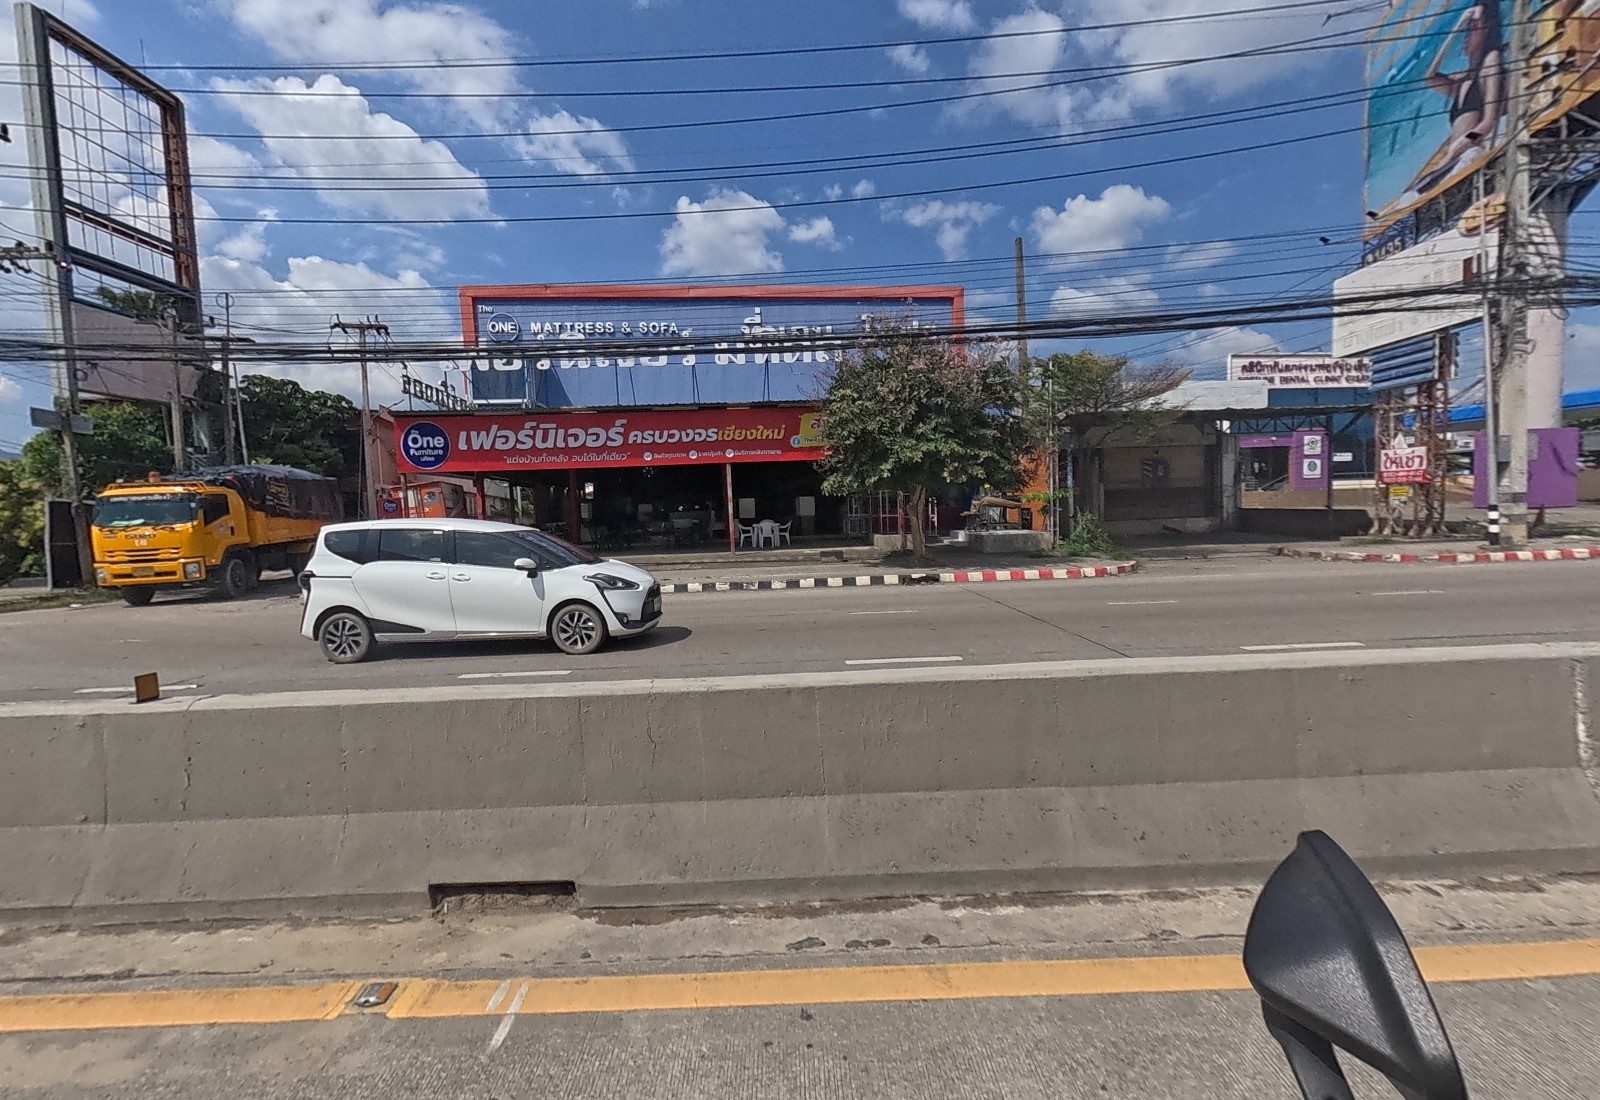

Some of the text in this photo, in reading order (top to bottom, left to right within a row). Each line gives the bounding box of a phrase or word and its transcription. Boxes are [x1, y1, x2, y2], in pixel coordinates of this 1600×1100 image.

[477, 304, 493, 314] The
[488, 321, 516, 334] ONE
[530, 321, 679, 334] MATTRESS & SOFA
[407, 433, 445, 448] One
[458, 419, 627, 451] เฟอร์นิเจอร์
[410, 448, 444, 456] Furniture
[1383, 450, 1424, 470] ให้เช่า
